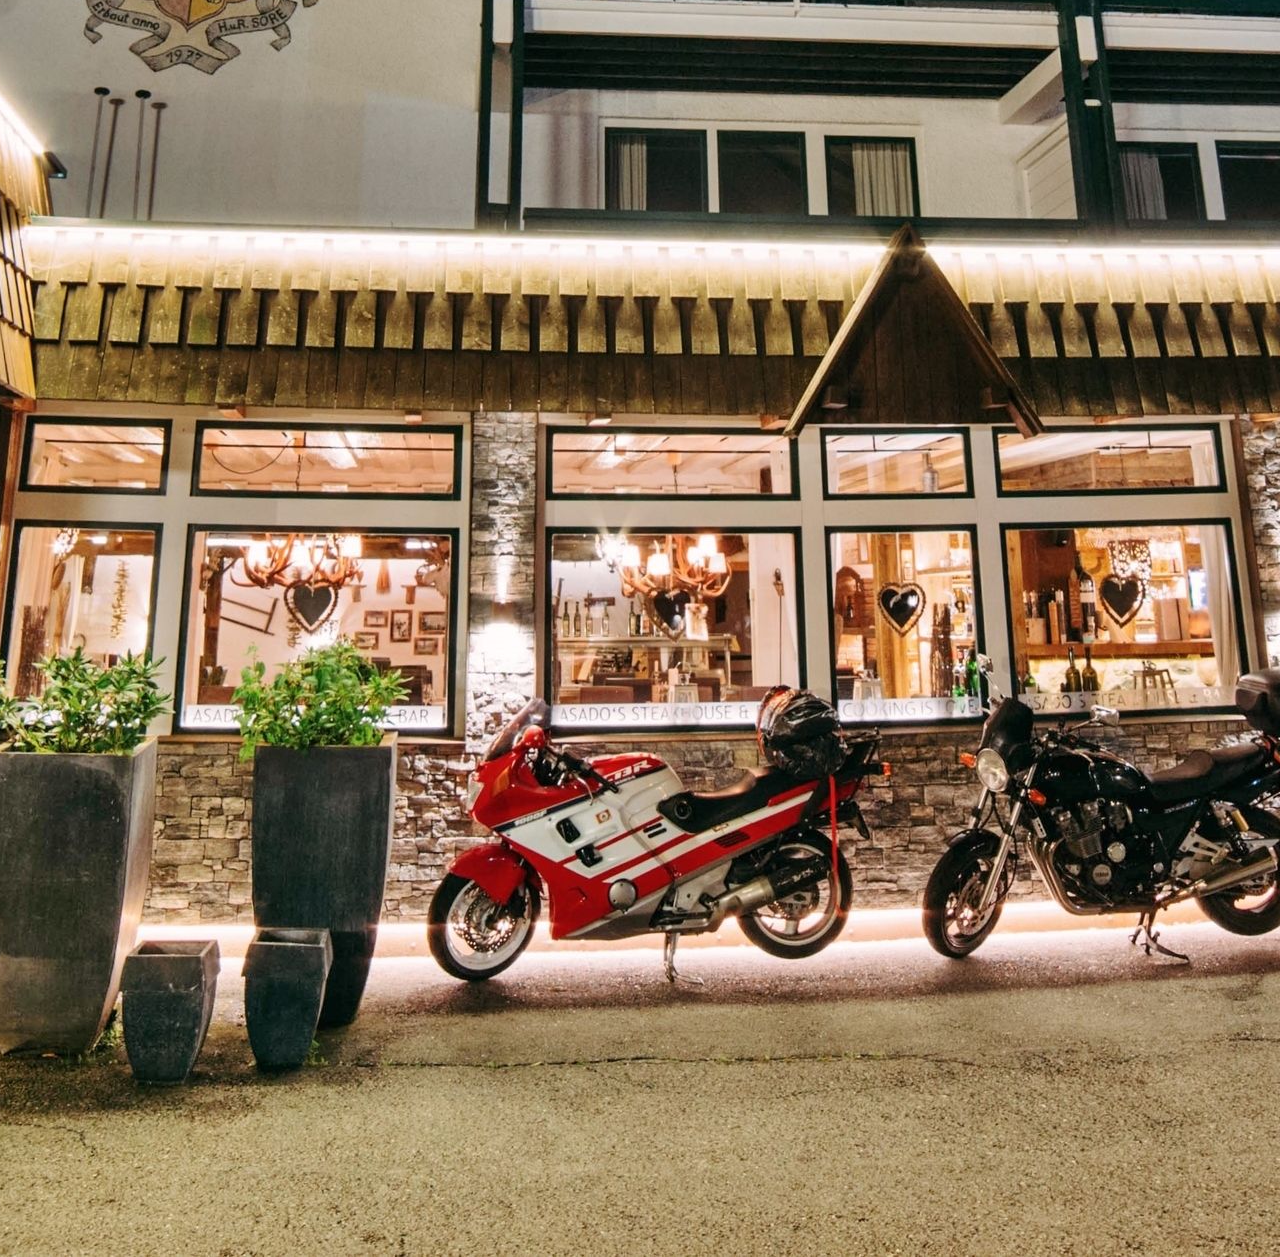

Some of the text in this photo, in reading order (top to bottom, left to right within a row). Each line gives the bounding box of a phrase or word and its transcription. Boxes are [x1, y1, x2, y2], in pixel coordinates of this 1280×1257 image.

[92, 1, 160, 30] Erbaut anno
[192, 707, 239, 724] ASAD
[397, 708, 429, 725] BAR
[560, 705, 625, 723] ASADO'S
[631, 704, 733, 722] STEAKHOUSE
[738, 705, 749, 720] &
[842, 700, 916, 719] COOKING
[920, 700, 934, 716] IS
